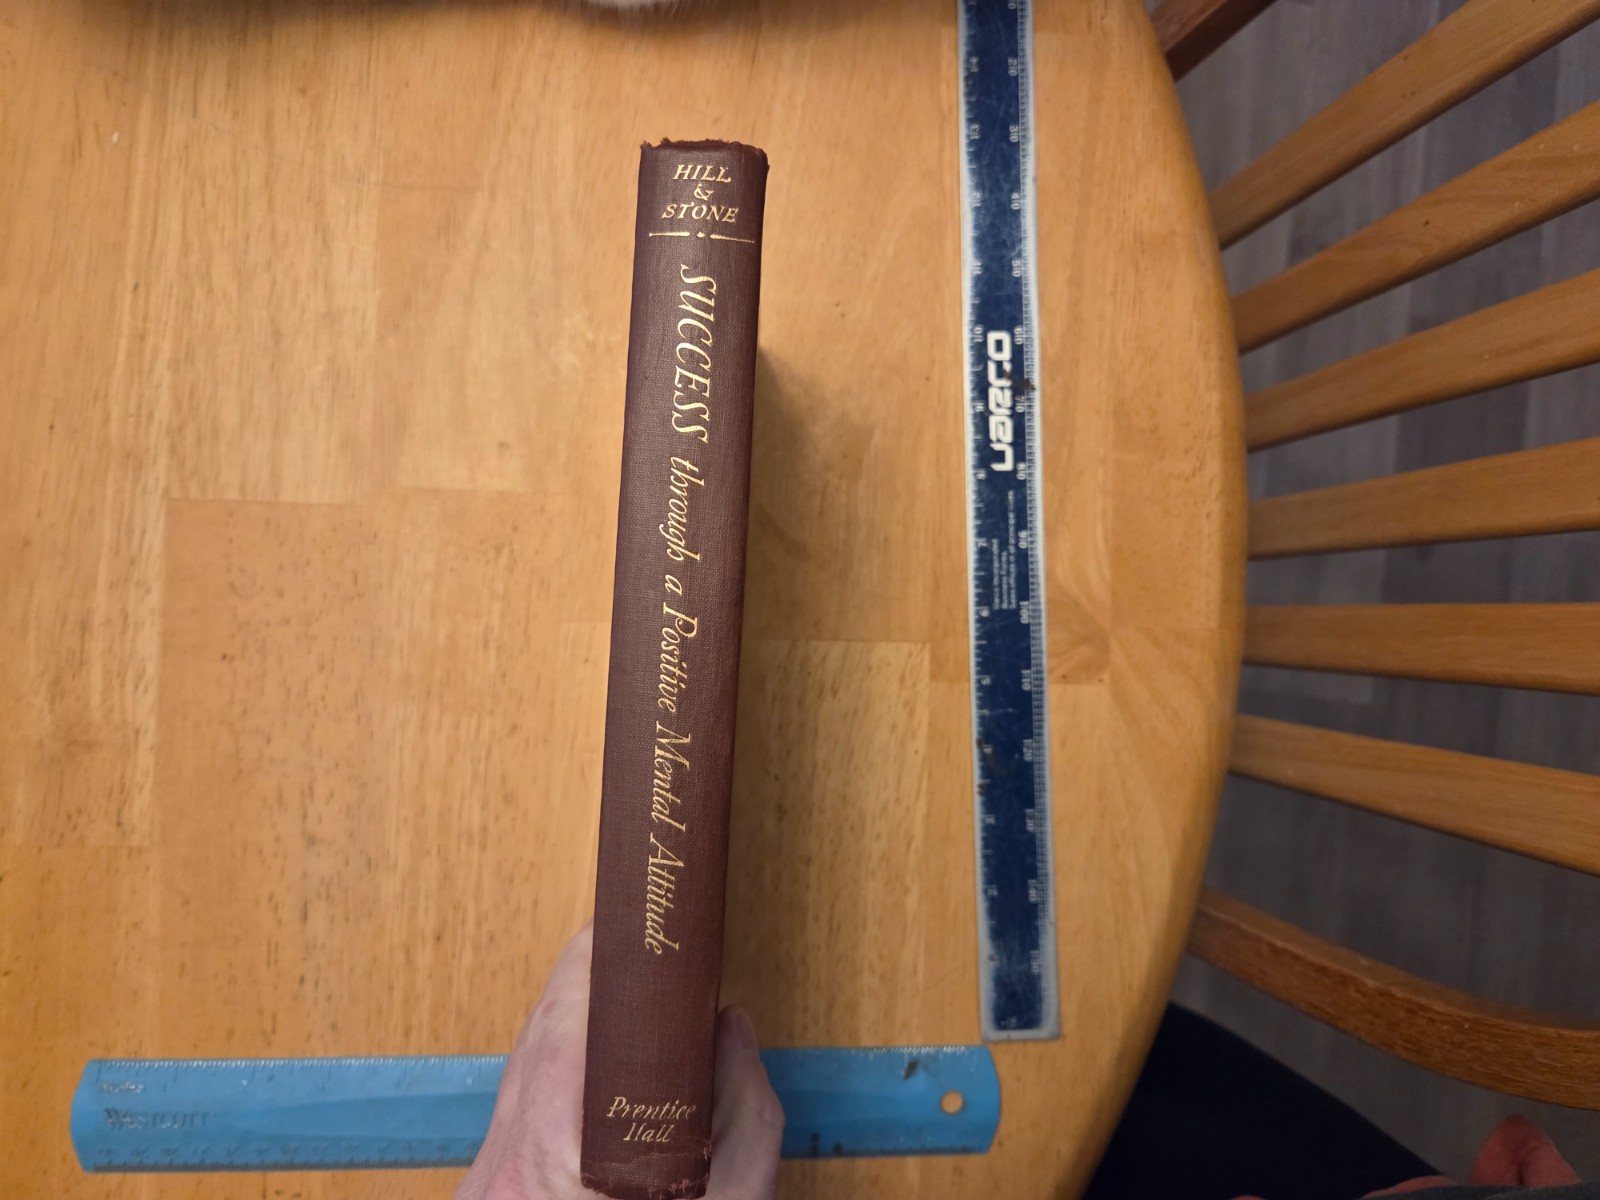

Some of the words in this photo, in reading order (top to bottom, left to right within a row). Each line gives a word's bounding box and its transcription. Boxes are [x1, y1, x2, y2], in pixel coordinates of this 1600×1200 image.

[1008, 56, 1018, 77] 20
[1009, 123, 1019, 143] 30
[672, 164, 732, 183] HILL
[693, 183, 714, 200] &
[971, 191, 982, 207] 12
[1011, 192, 1021, 210] 40
[661, 202, 739, 223] STONE
[1012, 258, 1022, 277] 50
[973, 325, 984, 343] 10
[1013, 325, 1024, 345] 60
[671, 264, 717, 443] SUCCESS
[1015, 394, 1025, 413] 70
[1016, 462, 1026, 480] 80
[659, 456, 705, 561] through
[1018, 529, 1028, 549] 90
[665, 574, 683, 596] a
[658, 602, 698, 713] Positive
[1021, 669, 1031, 691] 110
[1023, 739, 1033, 762] 120
[651, 720, 691, 832] Mental
[645, 832, 684, 955] Attitude
[606, 1096, 697, 1120] Prentice
[623, 1122, 675, 1143] Hall
